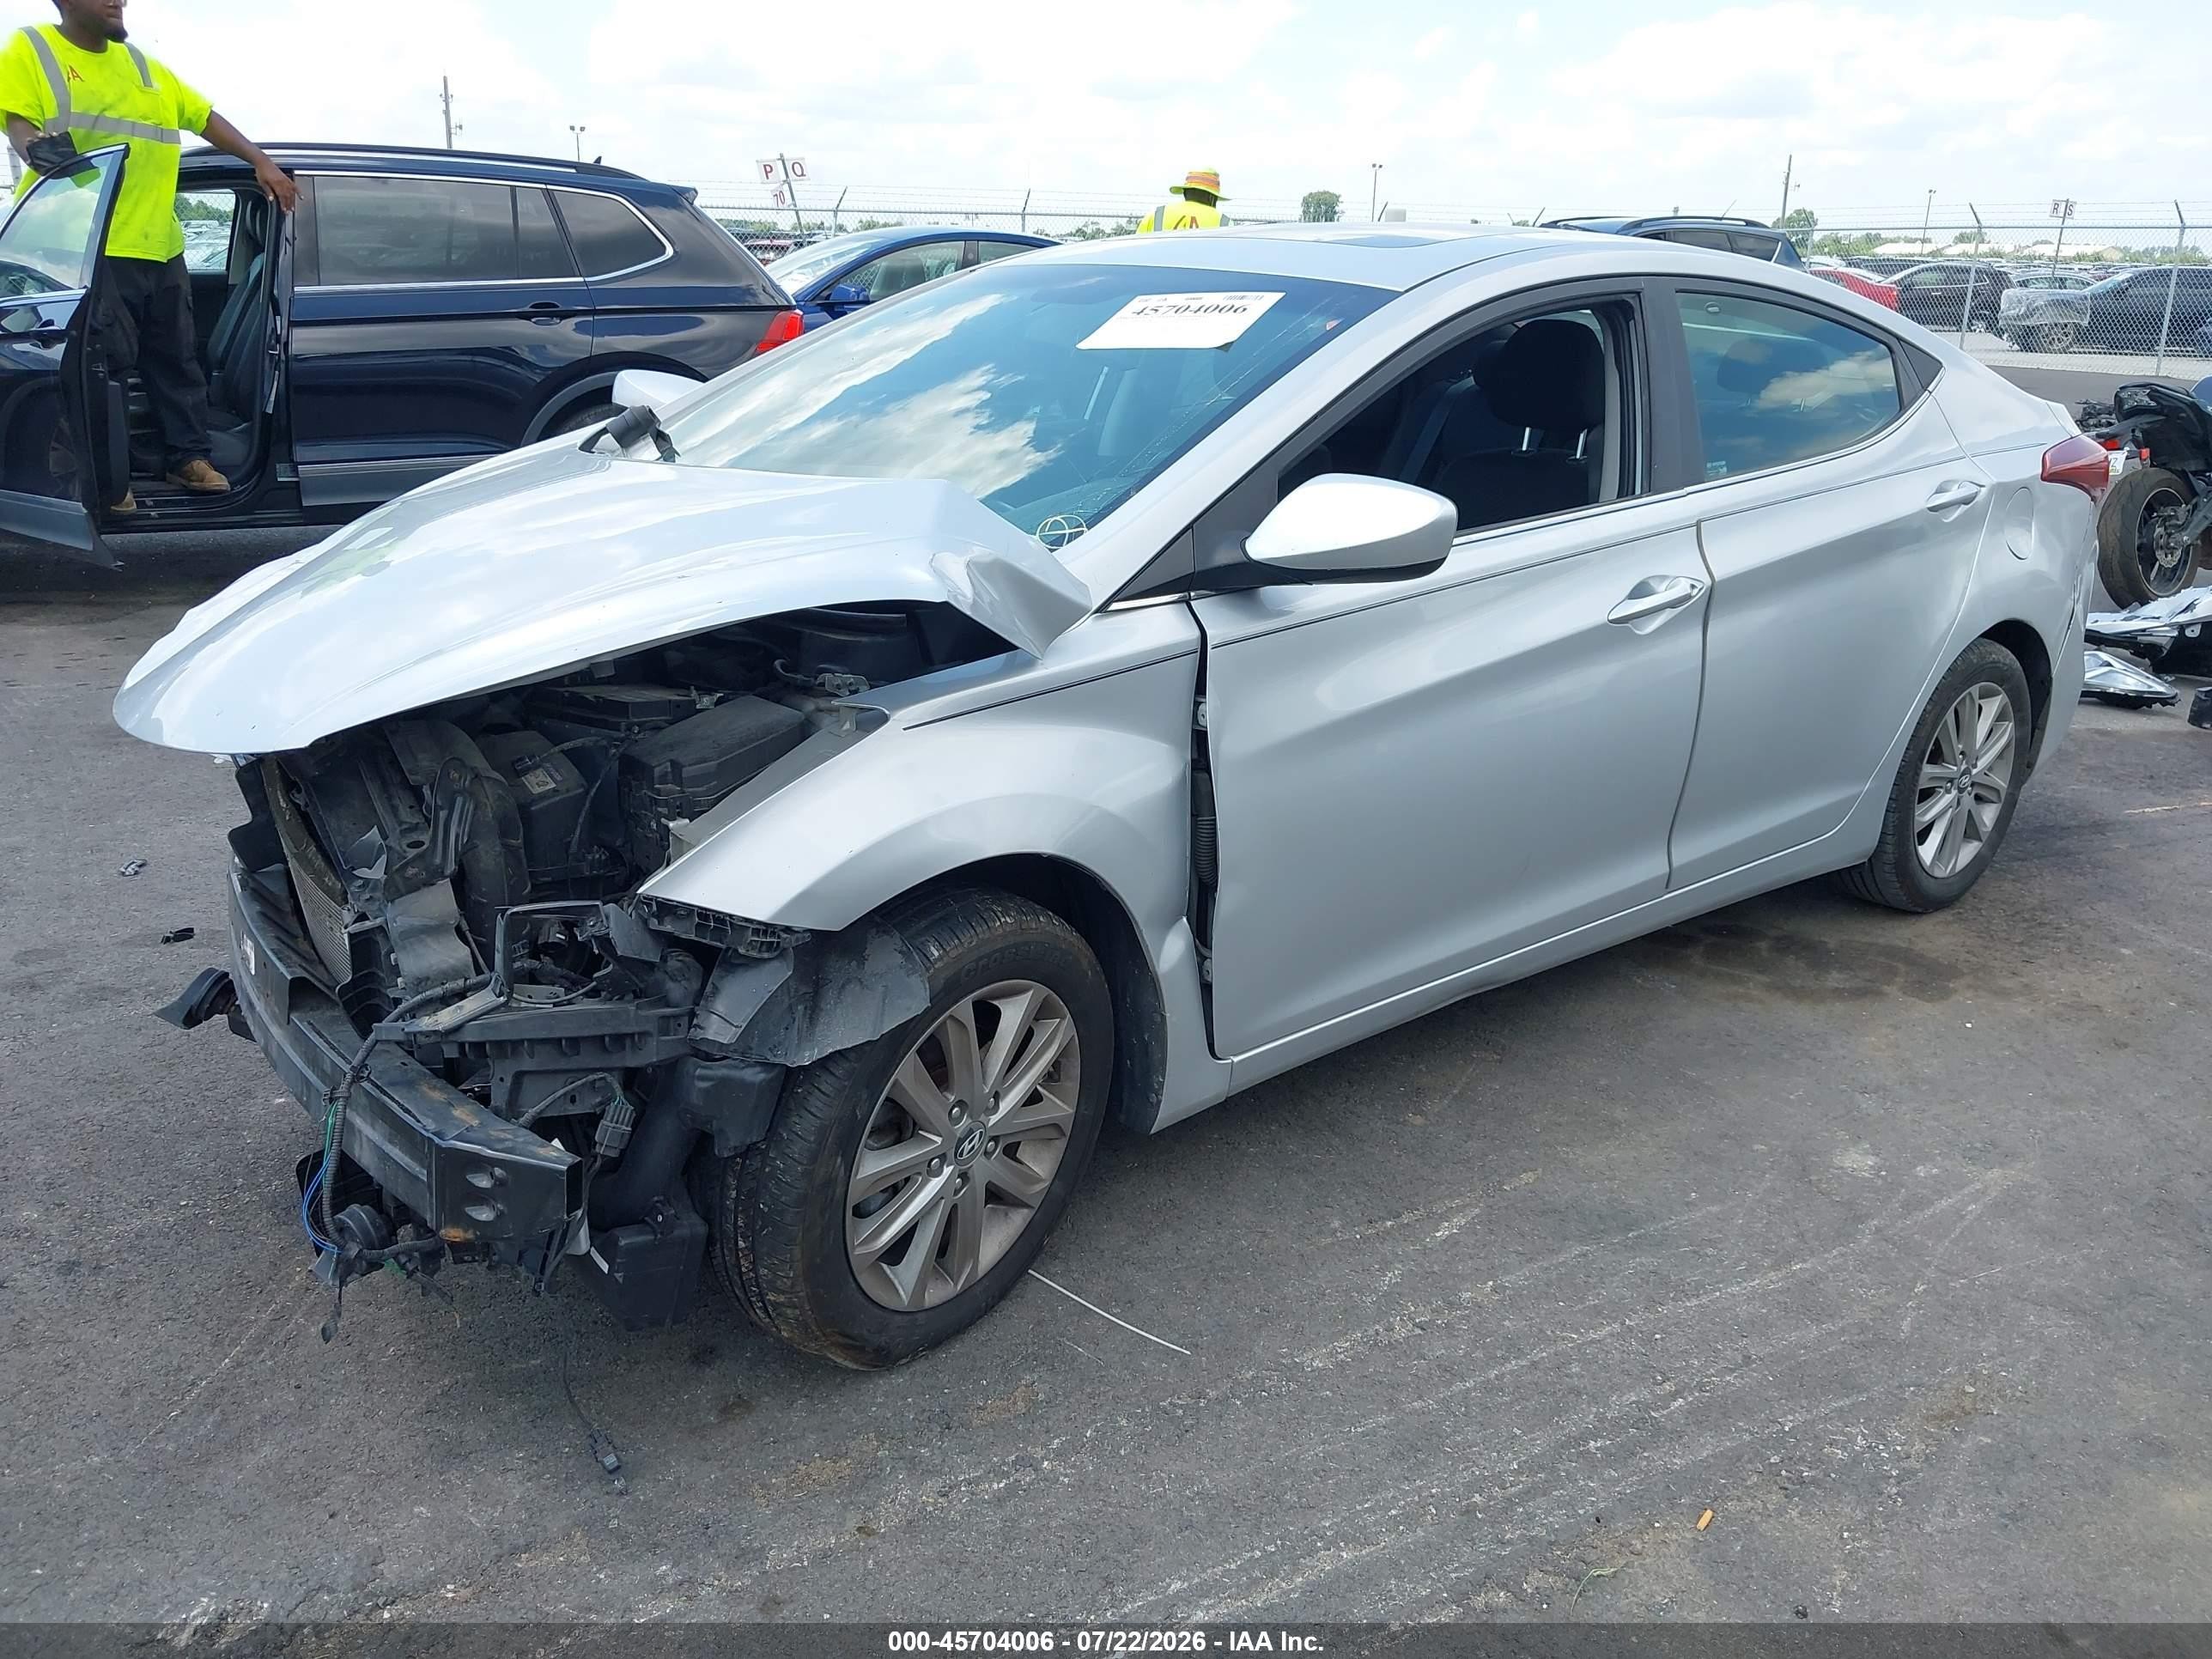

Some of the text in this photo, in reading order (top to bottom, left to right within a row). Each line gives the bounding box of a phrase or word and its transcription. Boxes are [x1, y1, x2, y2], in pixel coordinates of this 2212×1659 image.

[763, 163, 774, 180] P
[791, 161, 806, 178] Q
[773, 190, 786, 208] 70
[2052, 202, 2060, 215] R
[2067, 204, 2074, 216] S
